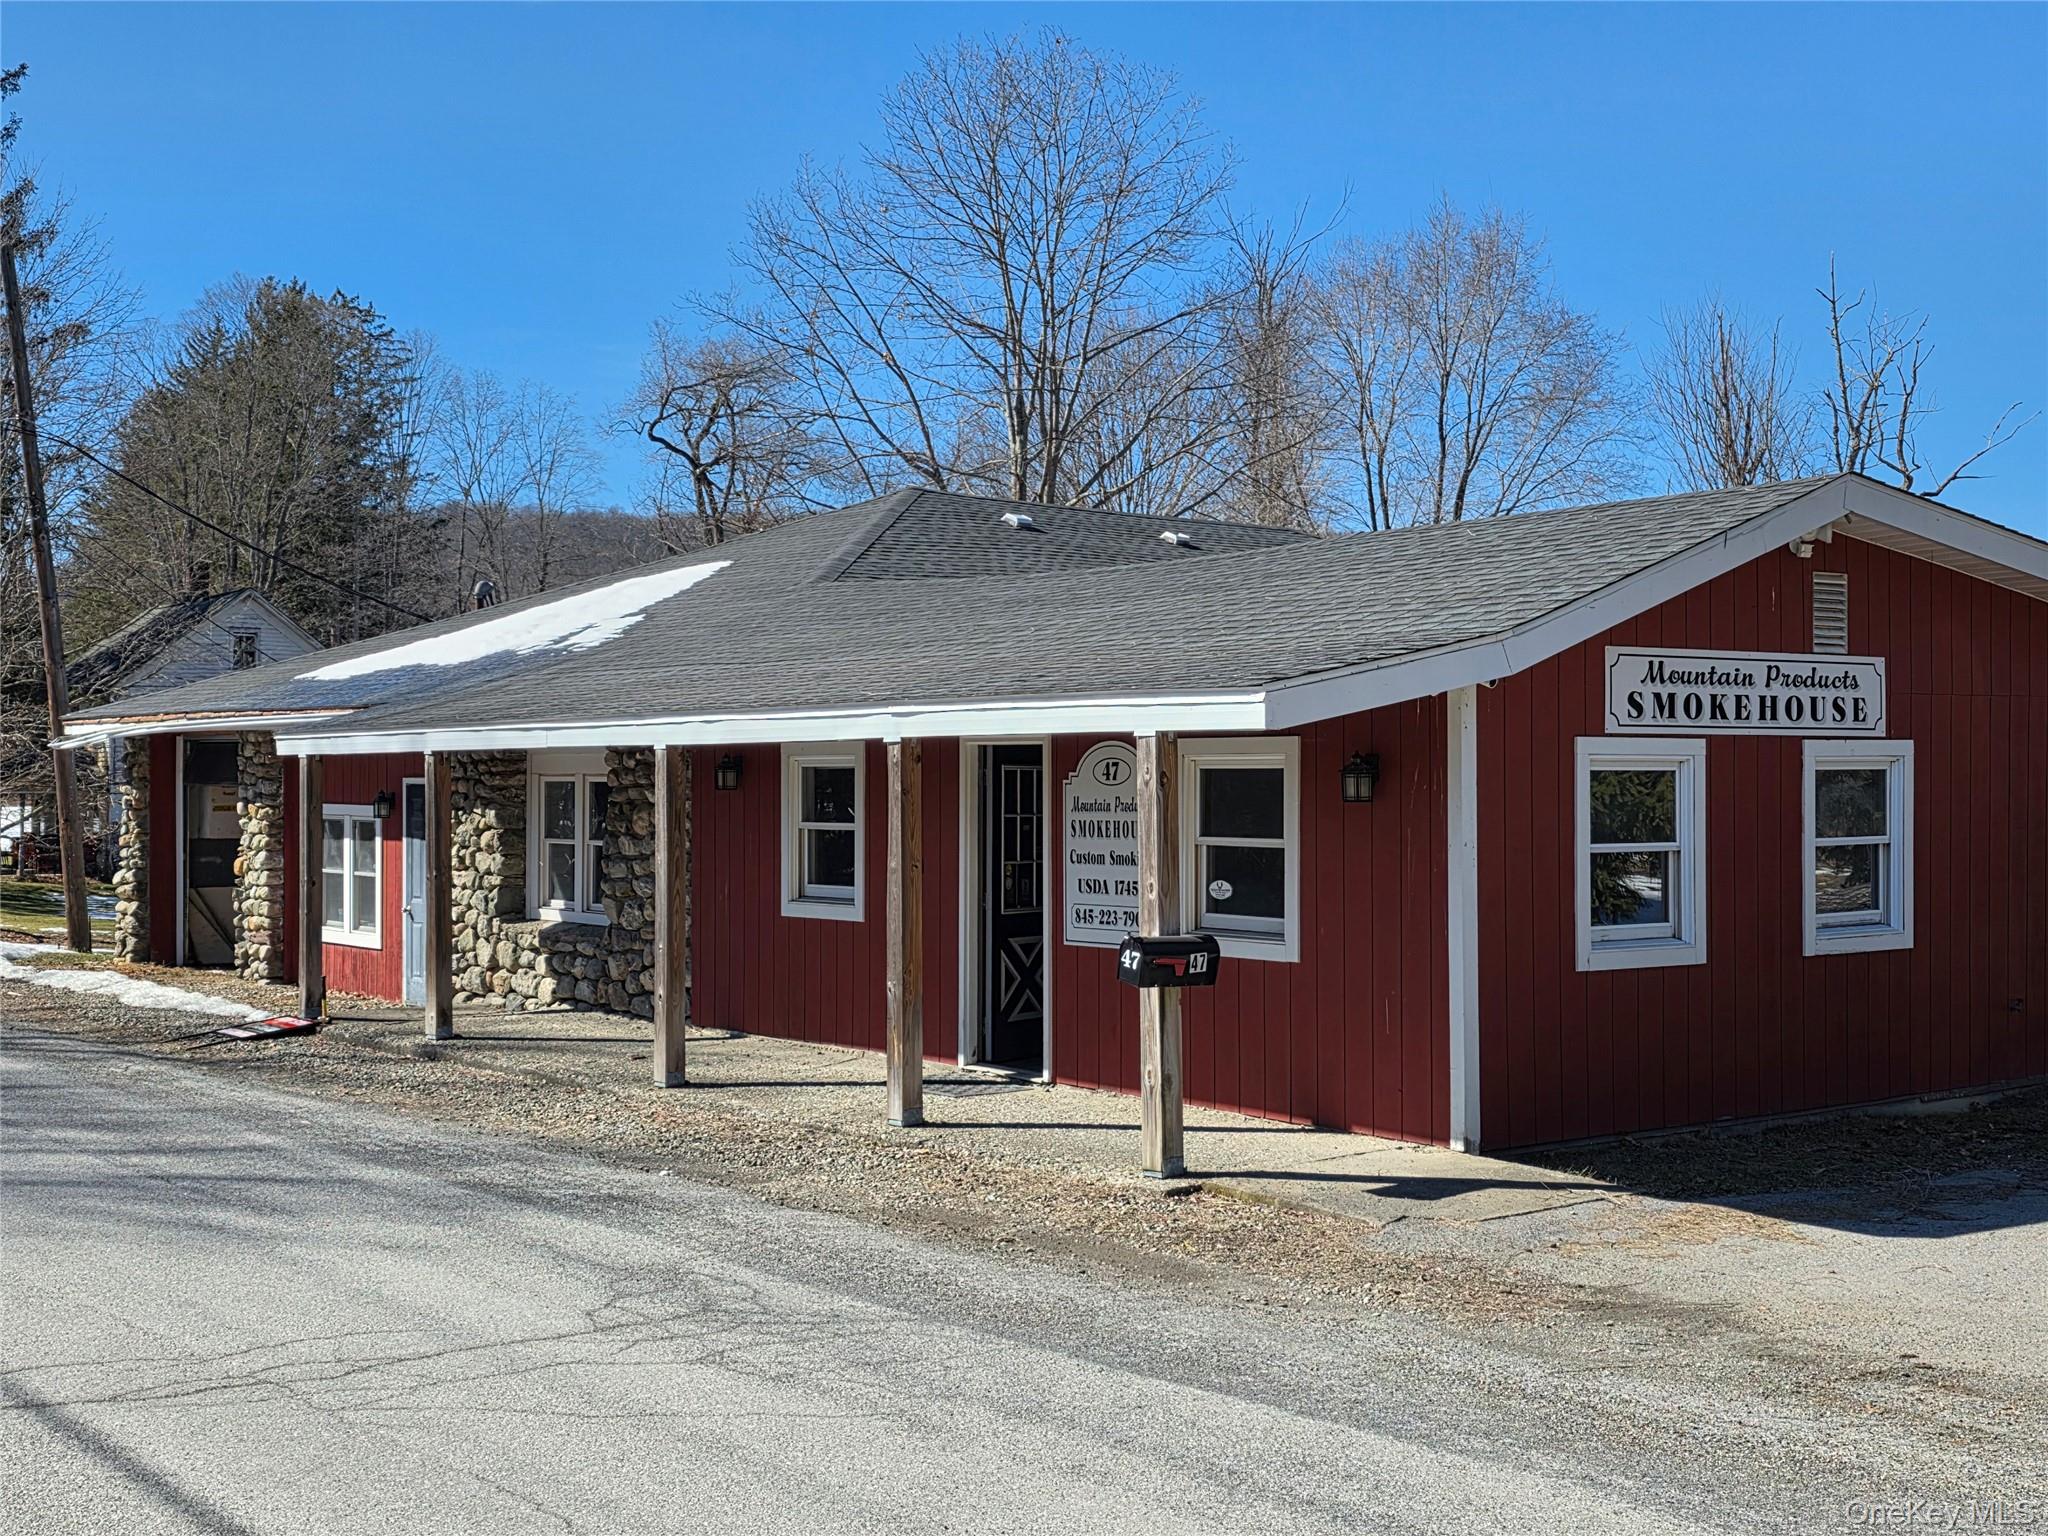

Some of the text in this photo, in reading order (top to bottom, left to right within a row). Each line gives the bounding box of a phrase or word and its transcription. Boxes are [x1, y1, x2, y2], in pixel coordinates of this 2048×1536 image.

[1640, 660, 1860, 690] Mountain Products
[1627, 690, 1868, 723] SMOKEHOUSE
[1101, 761, 1120, 781] 47
[1071, 795, 1111, 813] Mountain
[1069, 848, 1106, 865] Custom
[1077, 878, 1110, 895] USDA
[1120, 949, 1141, 971] 47
[1191, 954, 1206, 972] 47
